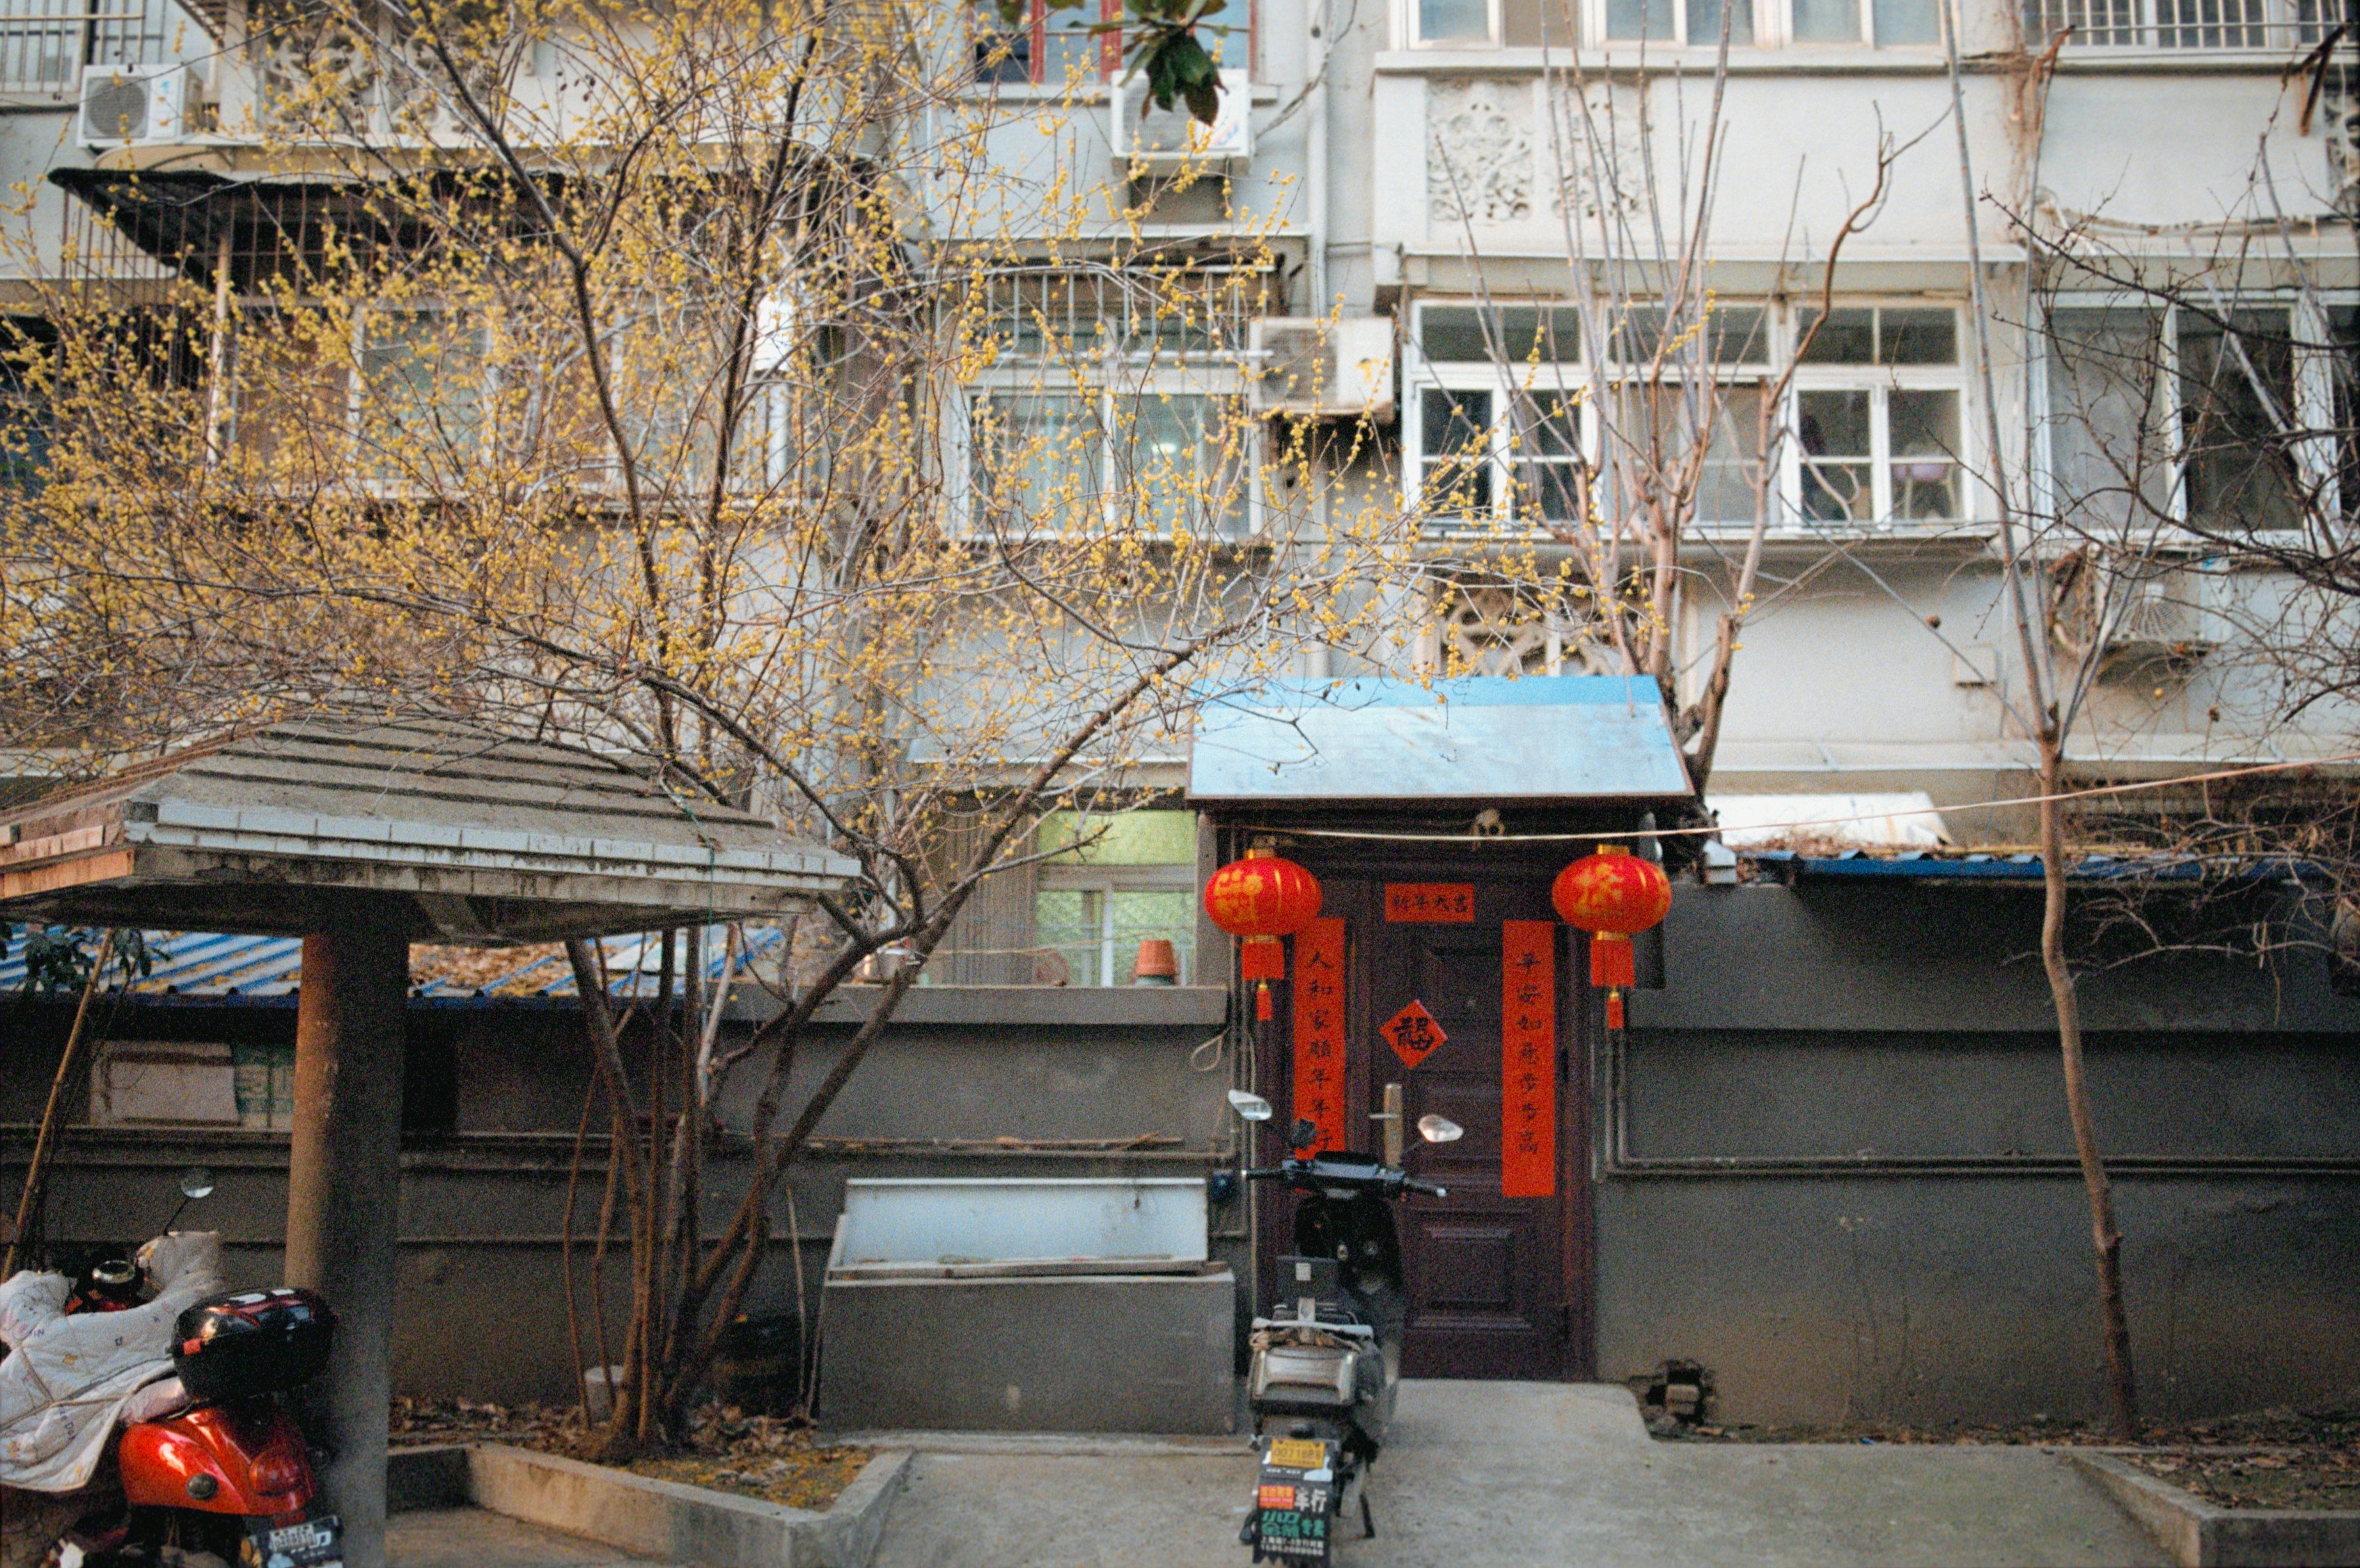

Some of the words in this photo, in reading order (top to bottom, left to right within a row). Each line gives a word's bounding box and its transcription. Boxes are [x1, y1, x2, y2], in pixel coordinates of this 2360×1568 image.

[1393, 1016, 1435, 1051] 福
[1516, 951, 1542, 1154] 平安如意步步高
